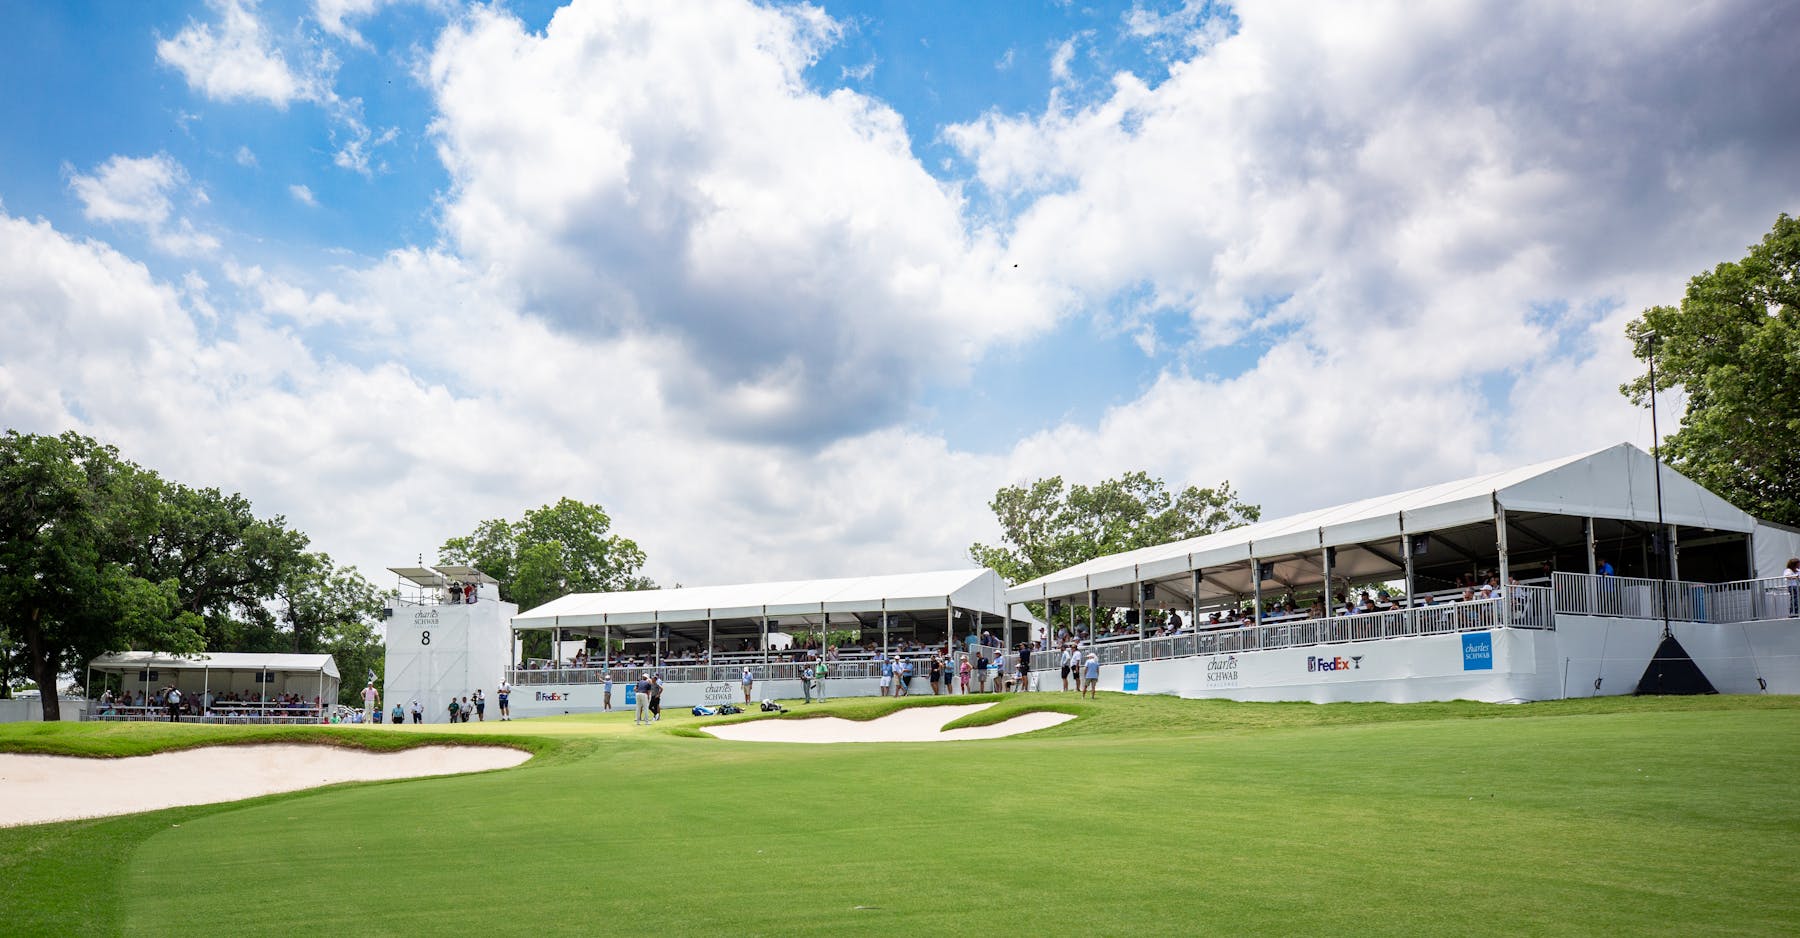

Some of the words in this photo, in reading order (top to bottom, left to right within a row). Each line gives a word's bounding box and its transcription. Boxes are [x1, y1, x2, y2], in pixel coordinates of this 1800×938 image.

[421, 630, 431, 645] 8
[1465, 642, 1490, 653] charles
[1207, 655, 1238, 671] charles
[1317, 656, 1350, 672] FedEx
[1207, 671, 1239, 681] SCHWAB
[705, 682, 732, 693] charles
[542, 692, 561, 701] FedEx
